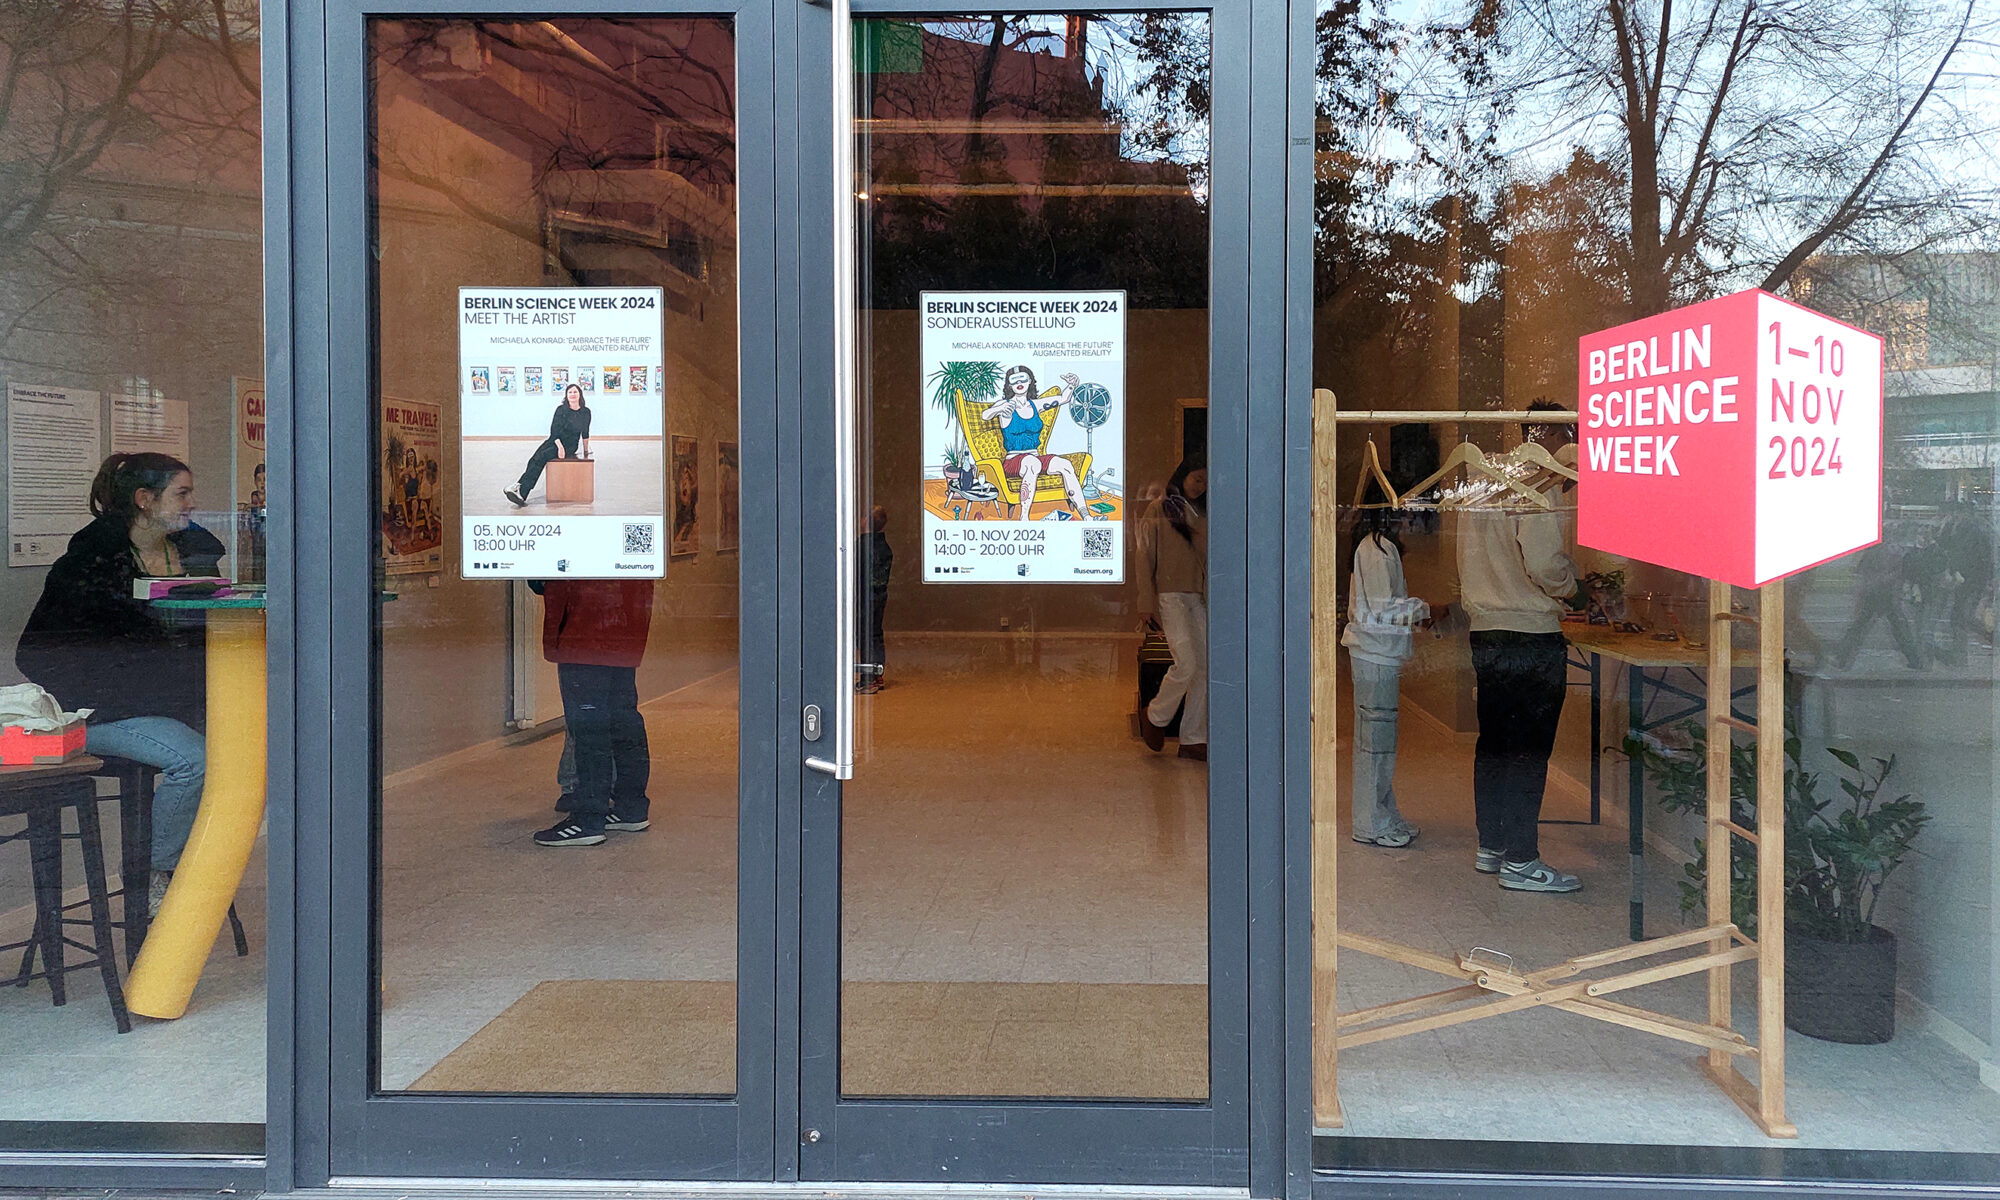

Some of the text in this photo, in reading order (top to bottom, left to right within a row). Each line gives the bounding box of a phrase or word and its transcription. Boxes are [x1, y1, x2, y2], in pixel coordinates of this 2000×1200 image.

[464, 296, 655, 310] BERLIN SCIENCE WEEK 2024
[927, 300, 1118, 314] BERLIN SCIENCE WEEK 2024
[464, 312, 576, 325] MEET THE ARTIST
[927, 316, 1076, 329] SONDERAUSSTELLUNG
[1589, 323, 1712, 386] BERLIN
[1587, 376, 1738, 428] SCIENCE
[1771, 378, 1844, 426] NOV
[402, 408, 438, 428] TRAVEL?
[246, 422, 266, 441] WIT
[1587, 435, 1680, 476] WEEK
[1768, 436, 1842, 480] 2024
[474, 524, 562, 536] 05. NOV 2024
[934, 530, 950, 541] 01.
[963, 530, 978, 541] 10.
[981, 530, 1010, 541] NOV
[1014, 530, 1046, 541] 2024
[474, 539, 536, 551] 18:00 UHR
[934, 544, 966, 556] 14:00
[980, 544, 1014, 556] 20:00
[1018, 544, 1045, 556] UHR
[614, 562, 654, 571] illuseum.org
[1074, 568, 1113, 576] illuseum.org
